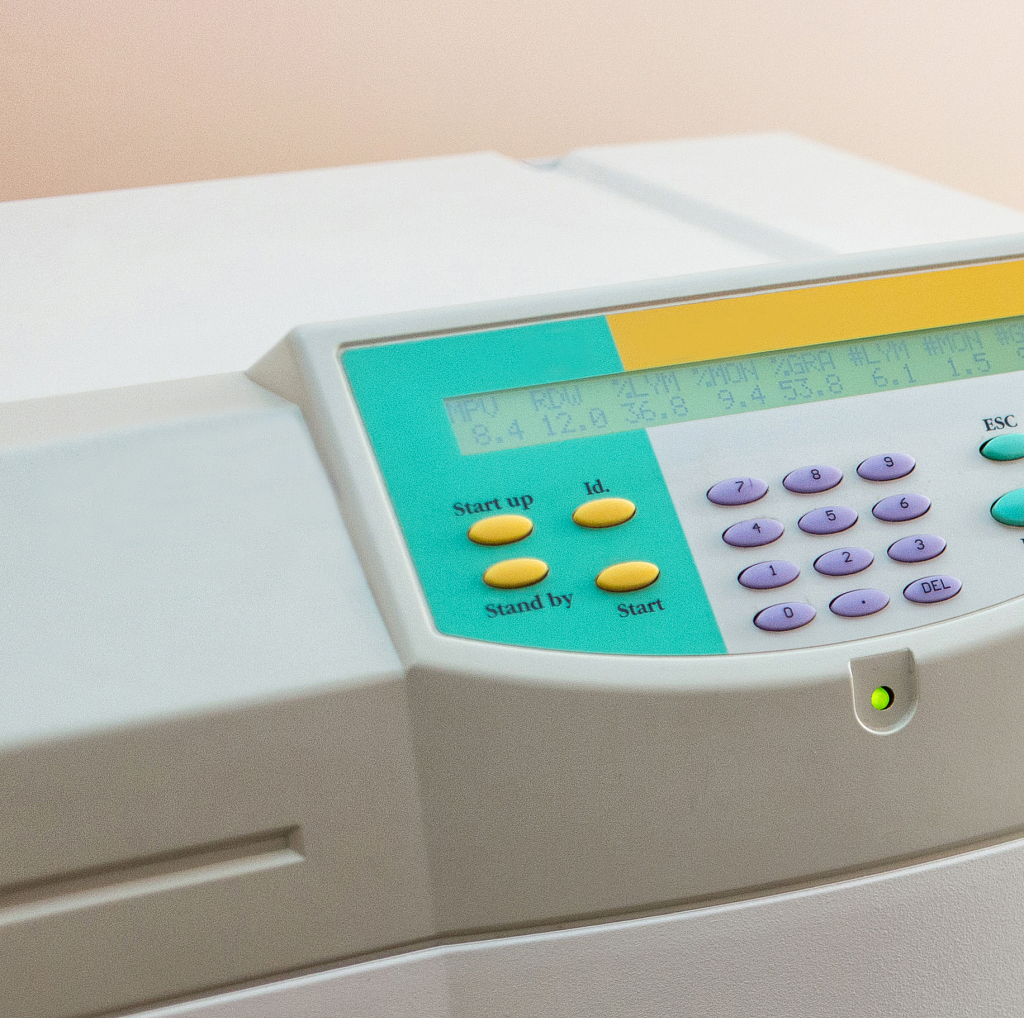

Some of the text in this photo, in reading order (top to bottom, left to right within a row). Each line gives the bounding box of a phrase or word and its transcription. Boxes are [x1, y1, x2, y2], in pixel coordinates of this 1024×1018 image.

[530, 385, 583, 412] RDW
[612, 372, 681, 399] %LYM
[692, 361, 760, 388] %MON
[769, 350, 837, 376] %GRA
[850, 339, 911, 367] #LYM
[922, 330, 984, 357] #MON
[472, 419, 525, 446] 8.4
[542, 407, 609, 436] 12.0
[620, 396, 689, 424] 36.8
[717, 385, 767, 410] 9.4
[779, 374, 844, 400] 53.8
[872, 364, 917, 388] 6.1
[948, 352, 992, 377] 1.5
[982, 414, 1018, 431] ESC
[883, 456, 894, 467] 9
[810, 468, 821, 480] 8
[584, 479, 610, 496] Id.
[735, 481, 745, 493] 7
[453, 494, 534, 516] Start up
[900, 497, 909, 509] 6
[825, 509, 836, 522] 5
[752, 522, 761, 534] 4
[914, 539, 925, 551] 3
[841, 551, 853, 563] 2
[769, 564, 777, 576] 1
[921, 579, 952, 594] DEL
[485, 592, 574, 618] Stand by
[617, 598, 666, 618] Start
[783, 607, 794, 619] 0
